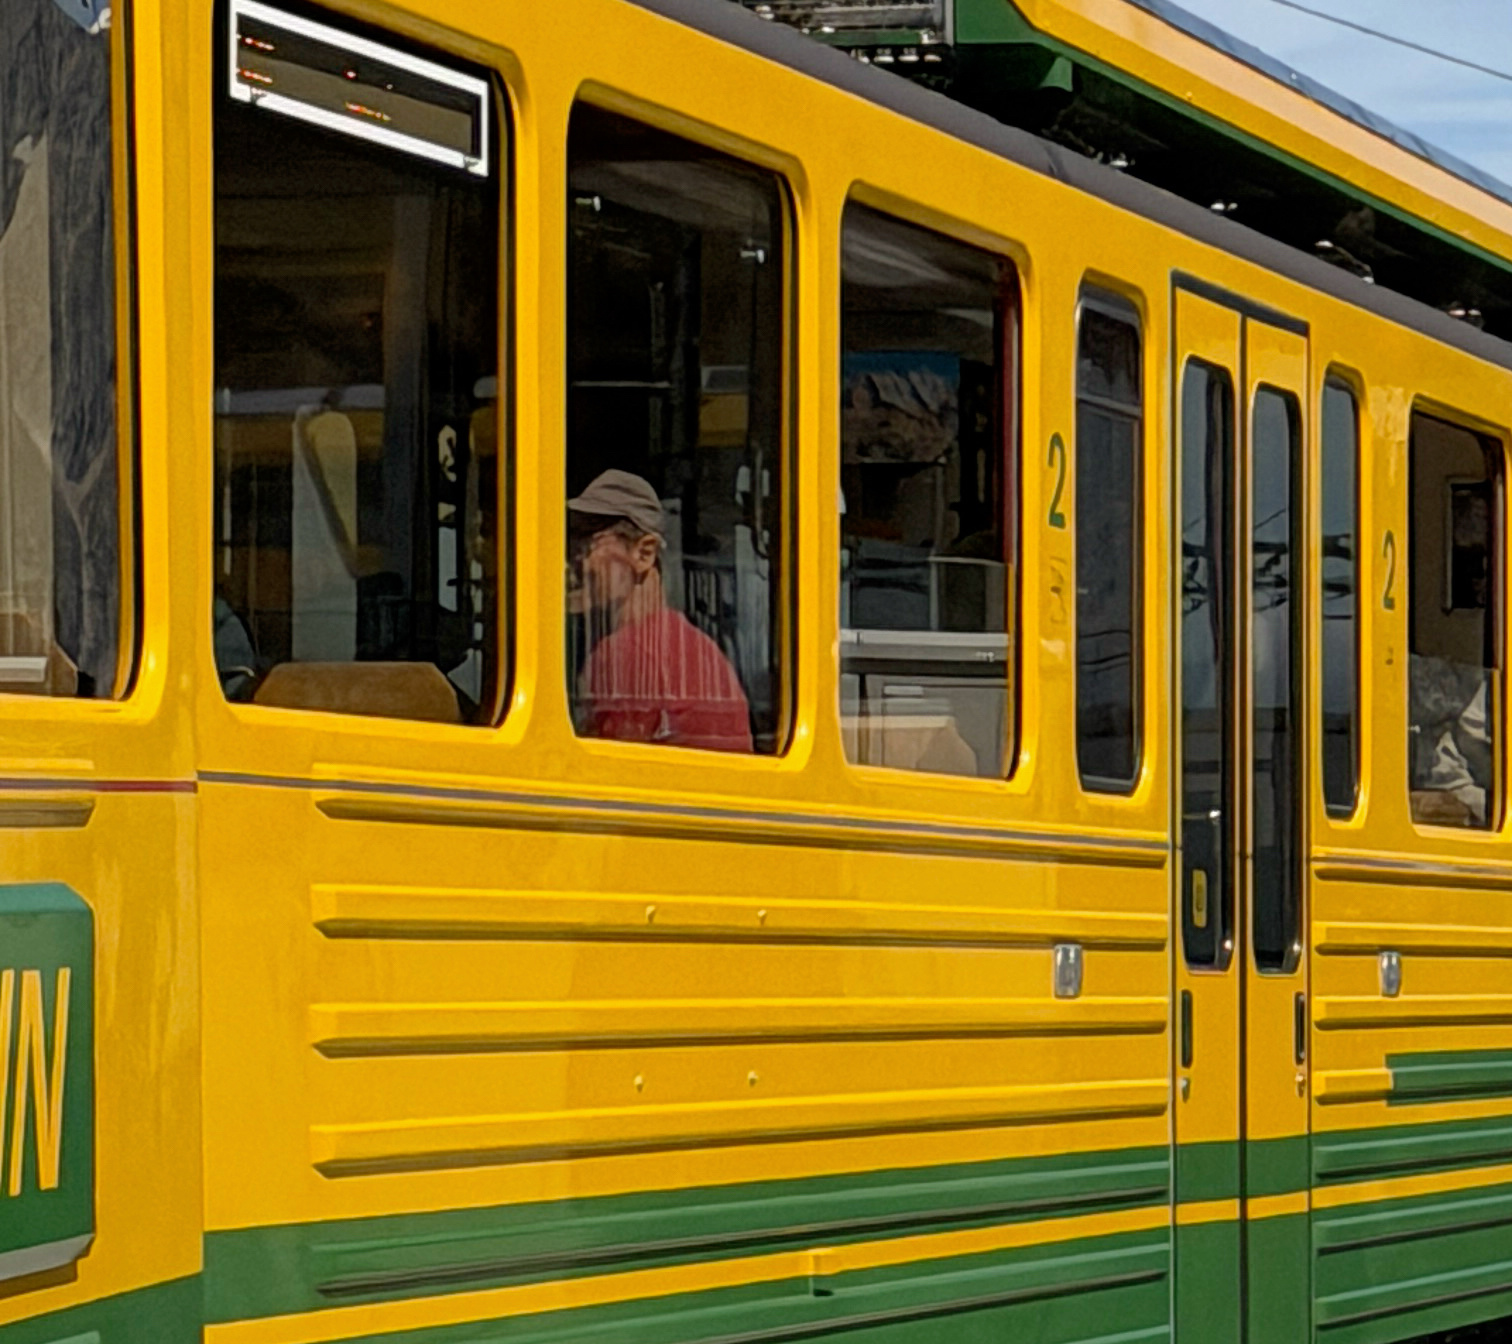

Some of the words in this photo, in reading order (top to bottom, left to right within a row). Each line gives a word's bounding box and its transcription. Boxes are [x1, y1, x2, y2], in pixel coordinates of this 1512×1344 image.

[1047, 431, 1067, 530] 2
[1383, 529, 1396, 611] 2
[0, 967, 71, 1197] N
